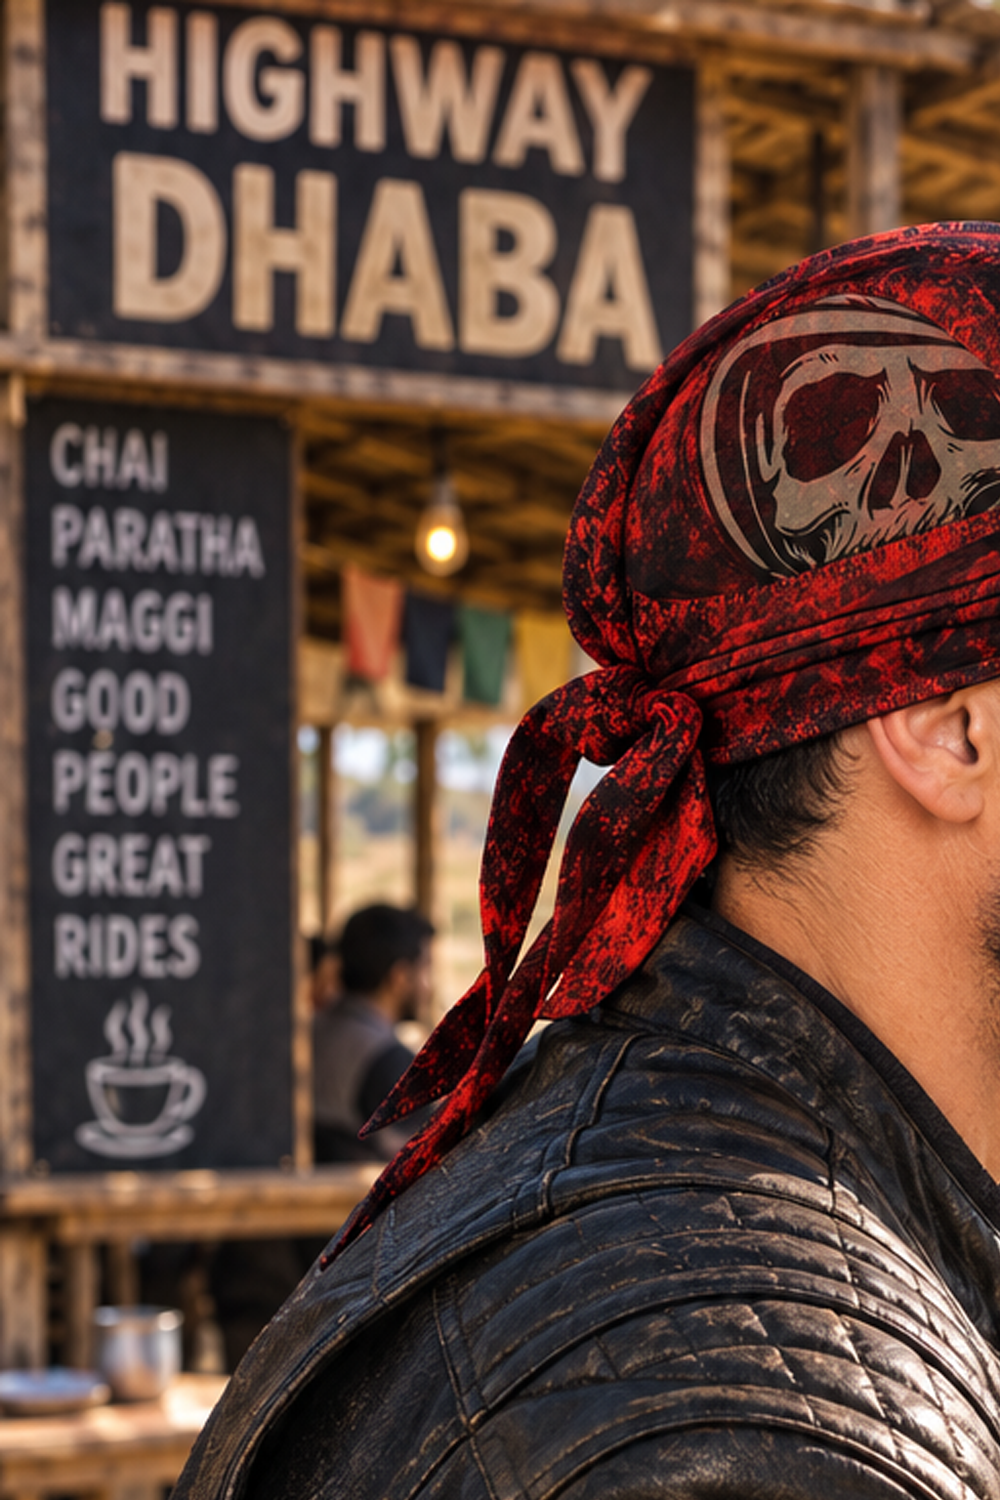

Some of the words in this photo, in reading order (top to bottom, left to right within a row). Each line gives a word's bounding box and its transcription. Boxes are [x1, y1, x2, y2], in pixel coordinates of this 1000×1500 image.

[100, 3, 653, 182] HIGHWAY
[112, 150, 664, 372] DHABA
[50, 423, 168, 492] CHAI
[51, 504, 264, 578] PARATHA
[51, 587, 213, 655] MAGGI
[51, 668, 191, 736] GOOD
[53, 749, 240, 817] PEOPLE
[51, 832, 210, 897] GREAT
[54, 913, 201, 979] RIDES
